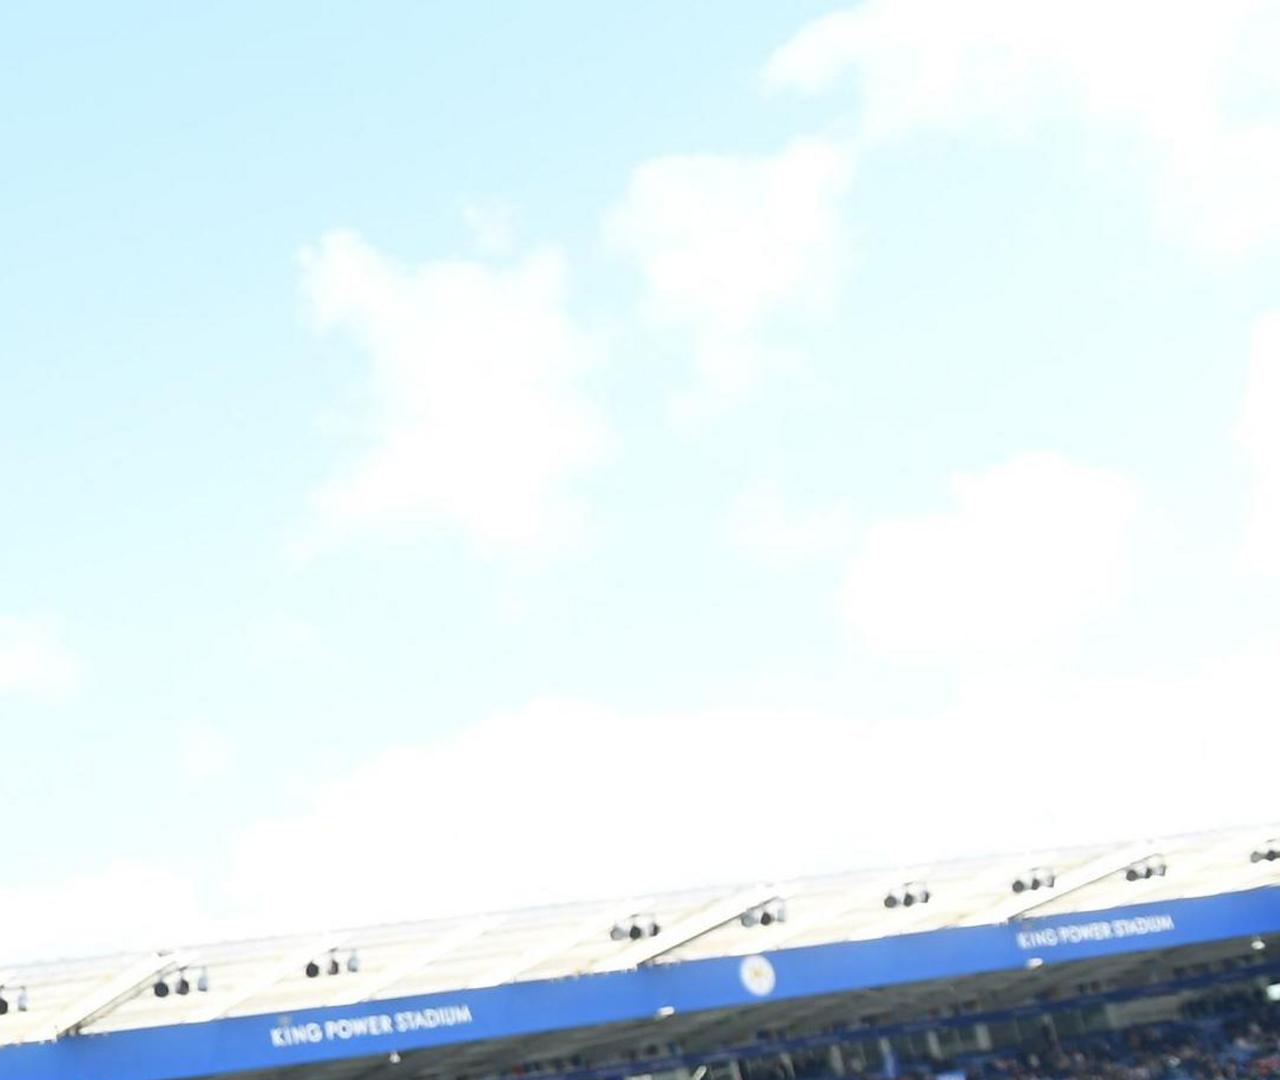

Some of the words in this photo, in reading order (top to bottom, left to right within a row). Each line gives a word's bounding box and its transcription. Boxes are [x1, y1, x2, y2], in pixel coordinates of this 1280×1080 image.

[1017, 928, 1058, 949] KING
[1057, 922, 1112, 944] POWER
[270, 1022, 323, 1047] KING
[324, 1014, 393, 1041] POWER
[393, 1004, 473, 1032] STADIUM
